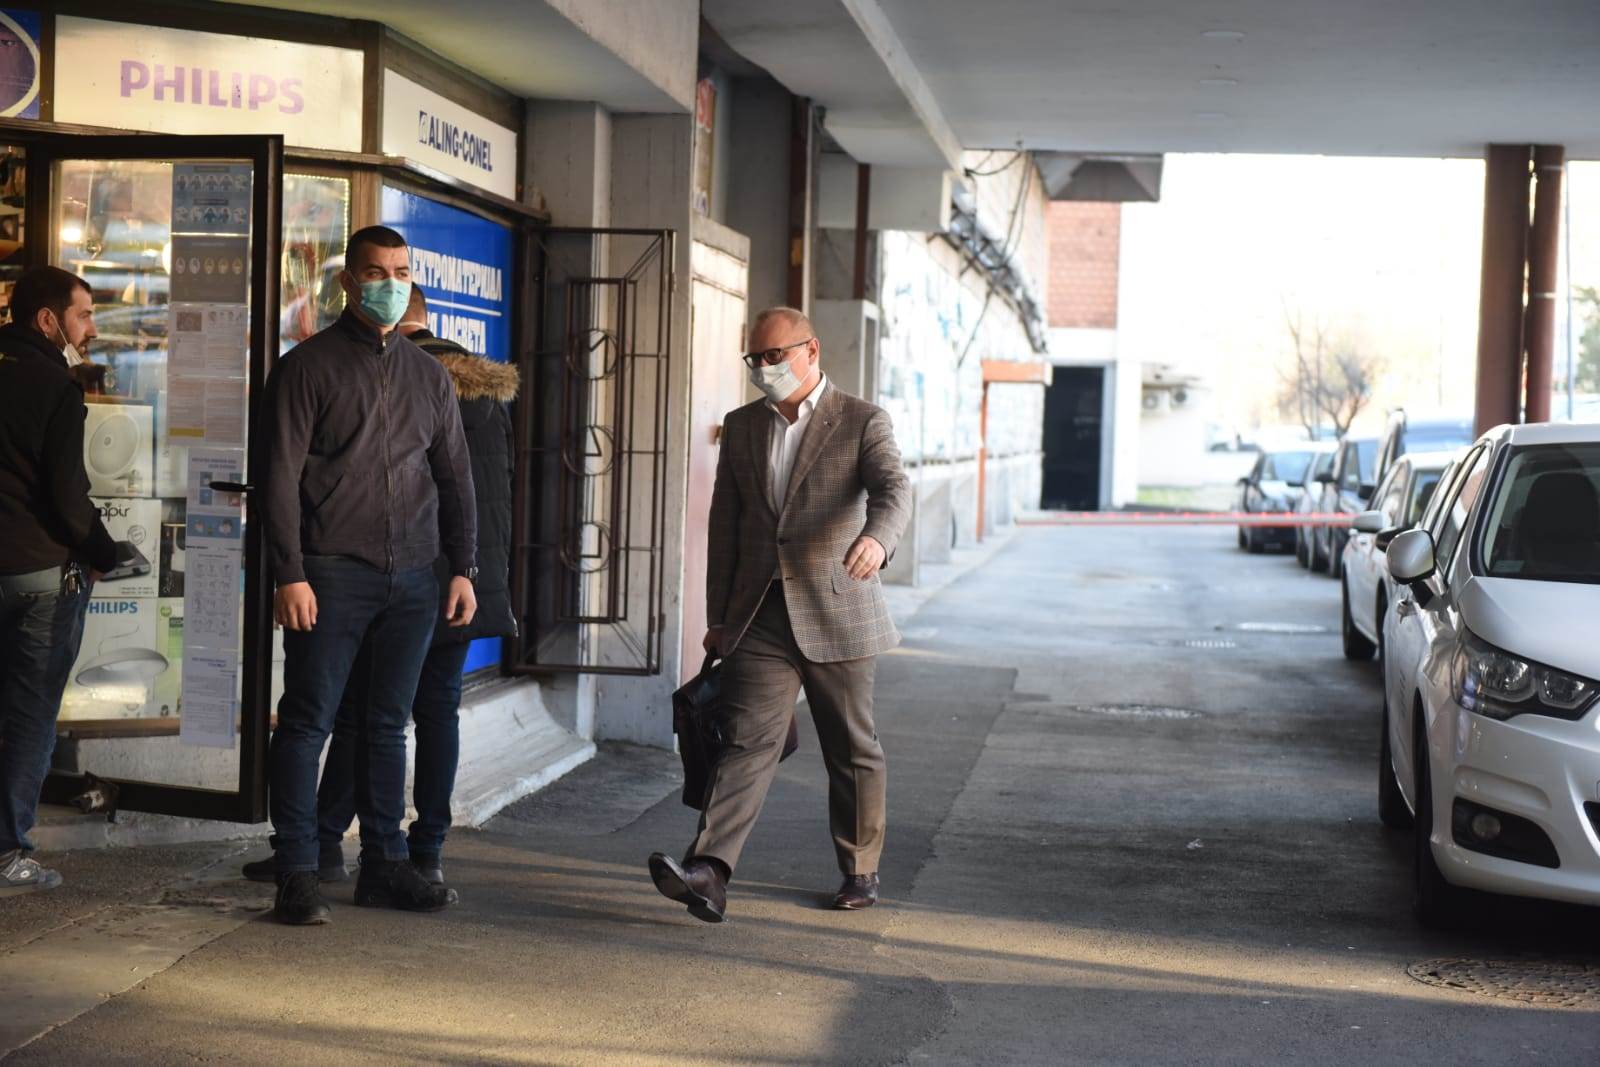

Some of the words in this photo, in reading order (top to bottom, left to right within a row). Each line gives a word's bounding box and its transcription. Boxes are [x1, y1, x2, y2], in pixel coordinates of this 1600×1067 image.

[120, 59, 305, 115] PHILIPS
[428, 116, 493, 172] ALING-CONEL
[100, 503, 130, 522] apir
